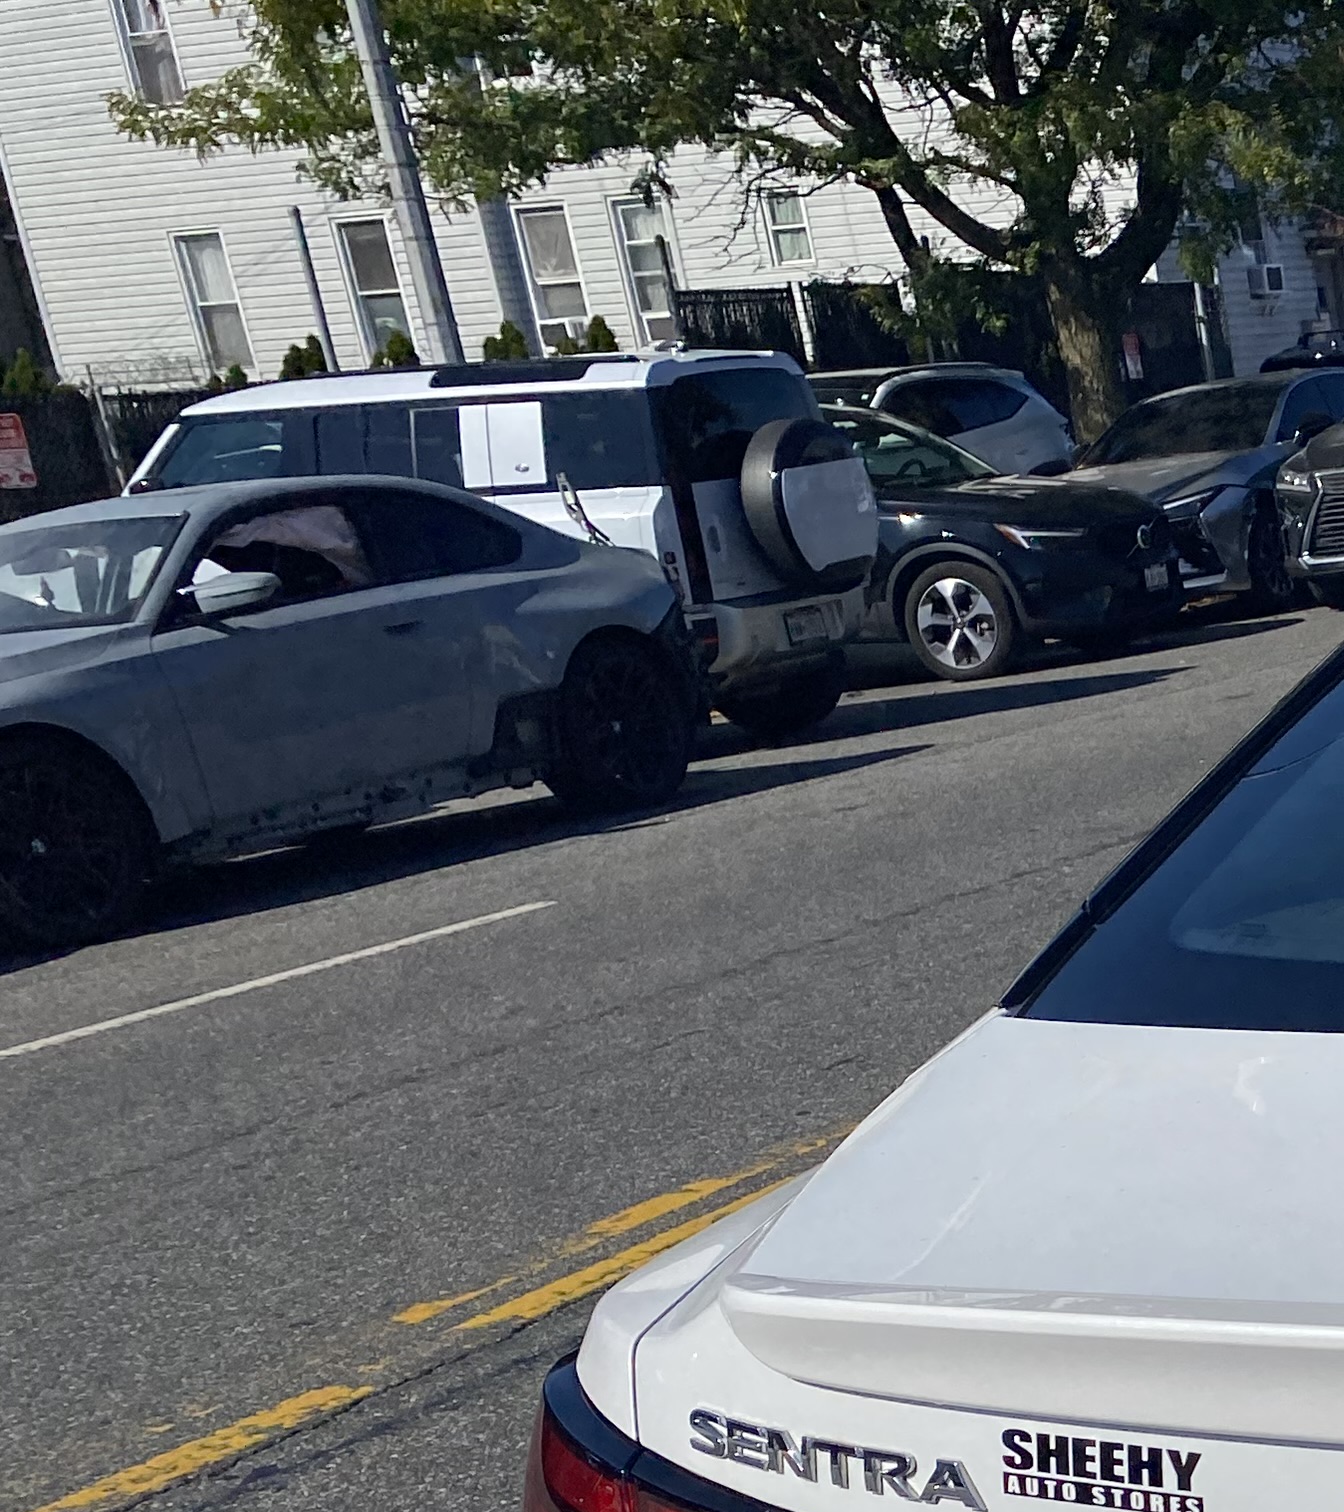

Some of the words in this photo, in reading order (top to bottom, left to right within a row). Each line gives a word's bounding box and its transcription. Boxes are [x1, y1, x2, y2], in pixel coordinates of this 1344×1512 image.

[688, 1406, 989, 1512] SENTRA
[1001, 1427, 1202, 1492] SHEEHY
[1006, 1476, 1075, 1502] AUTO
